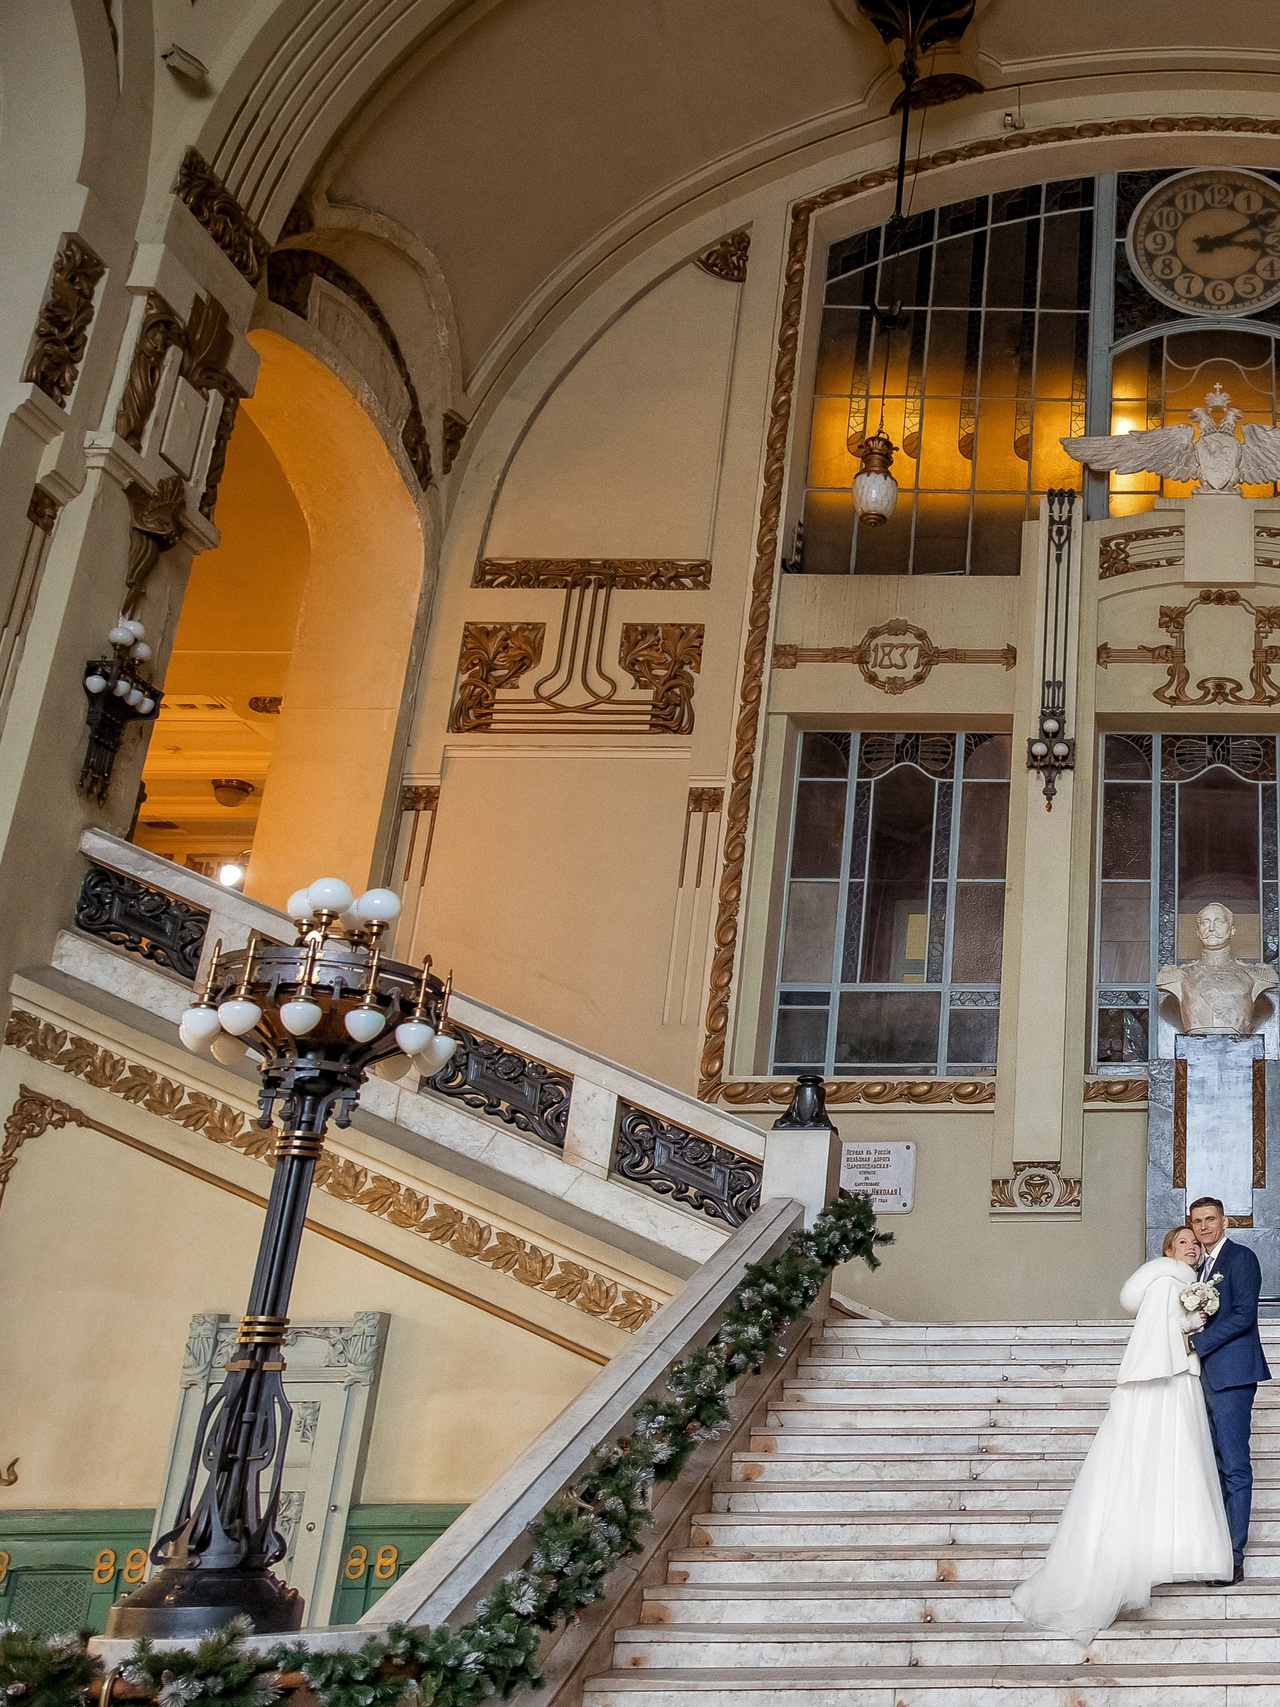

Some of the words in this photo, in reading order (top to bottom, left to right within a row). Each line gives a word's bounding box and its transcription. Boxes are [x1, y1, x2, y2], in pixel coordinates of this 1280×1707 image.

[1181, 193, 1198, 211] 11
[1209, 187, 1230, 206] 12
[1243, 194, 1254, 211] 1
[1158, 209, 1180, 228] 10
[1152, 233, 1167, 252] 9
[1160, 257, 1174, 277] 8
[1262, 259, 1278, 278] 4
[1182, 276, 1195, 295] 7
[1211, 282, 1226, 301] 6
[1242, 276, 1257, 295] 5
[871, 643, 922, 670] 1837
